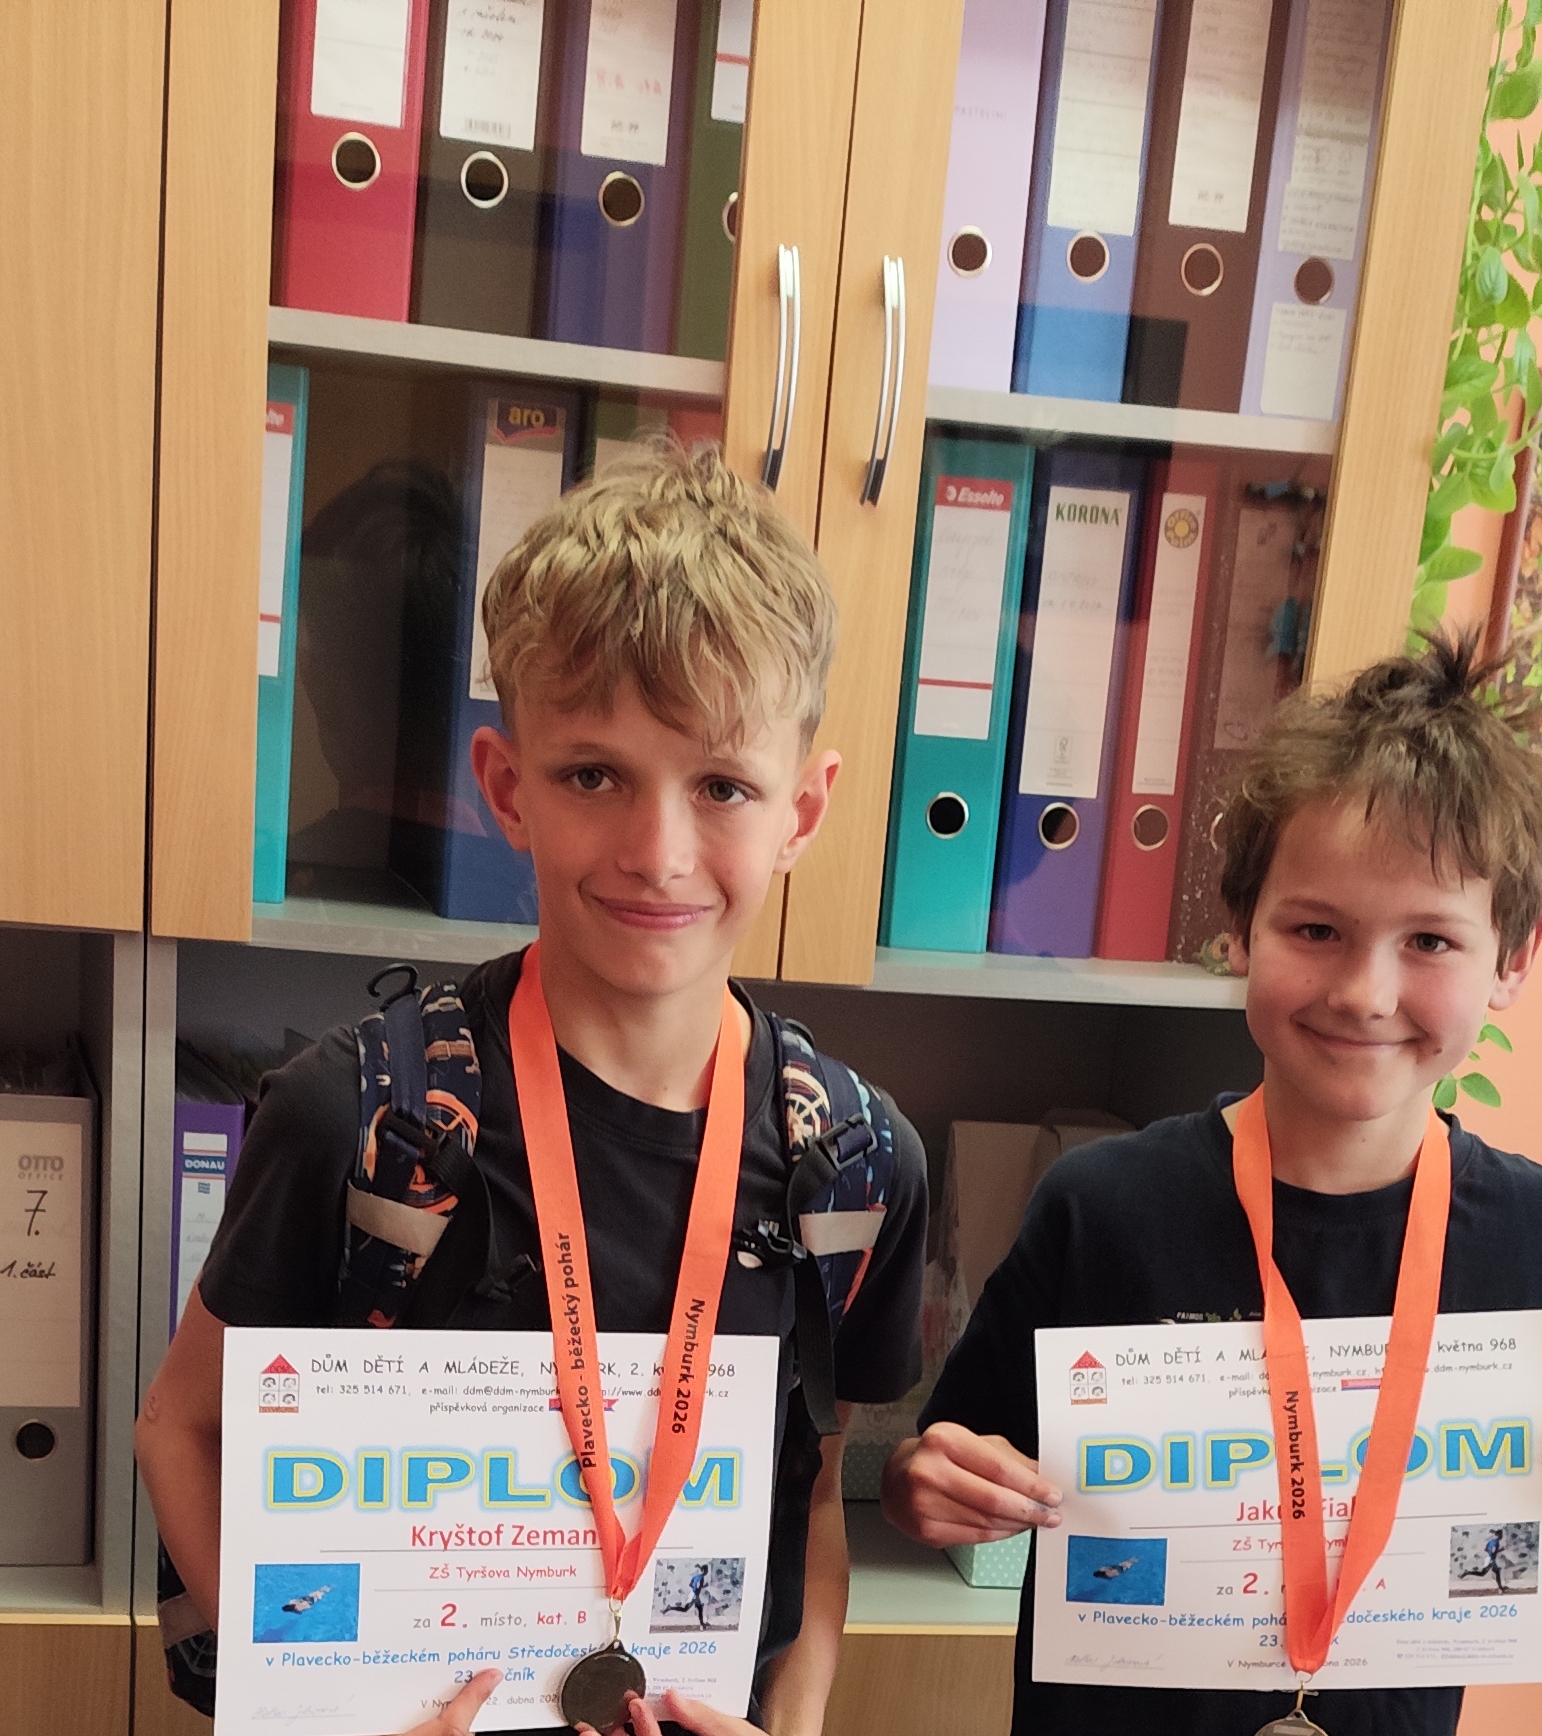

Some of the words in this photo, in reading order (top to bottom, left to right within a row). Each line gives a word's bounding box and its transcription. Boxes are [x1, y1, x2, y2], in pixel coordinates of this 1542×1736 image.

[509, 406, 546, 428] aro
[1055, 502, 1120, 527] KORONA
[18, 1154, 64, 1172] OTTO
[185, 1159, 225, 1171] DONAU
[18, 1172, 64, 1181] OFFICE
[24, 1190, 49, 1236] 7.
[557, 1232, 580, 1288] pohár
[564, 1293, 585, 1370] běžecký
[677, 1298, 705, 1384] Nymburk
[1115, 1347, 1151, 1367] DŮM
[1164, 1347, 1201, 1365] DĚTÍ
[1216, 1351, 1226, 1362] A
[1437, 1339, 1484, 1354] května
[1490, 1338, 1517, 1351] 968
[311, 1353, 348, 1373] DŮM
[363, 1355, 404, 1374] DĚTÍ
[419, 1360, 430, 1374] A
[444, 1356, 525, 1377] MLÁDEŽE,
[708, 1364, 735, 1377] 968
[339, 1384, 359, 1395] 325
[364, 1384, 384, 1395] 514
[430, 1402, 488, 1414] příspěvková
[492, 1403, 544, 1415] organizace
[671, 1387, 691, 1434] 2026
[576, 1385, 596, 1468] Plavecko
[1283, 1391, 1305, 1474] Nymburk
[1291, 1476, 1305, 1520] 2026
[411, 1523, 504, 1552] Kryštof
[1233, 1536, 1252, 1551] ZŠ
[429, 1563, 450, 1579] ZŠ
[456, 1565, 510, 1582] Tyršova
[517, 1564, 577, 1581] Nymburk
[1216, 1585, 1233, 1596] za
[1243, 1573, 1269, 1596] 2.
[1376, 1578, 1387, 1590] A
[413, 1618, 431, 1629] za
[440, 1603, 468, 1629] 2.
[480, 1612, 527, 1628] místo,
[536, 1611, 568, 1626] kat.
[577, 1611, 587, 1624] B
[1078, 1613, 1087, 1623] v
[1093, 1611, 1244, 1627] Plavecko-běžeckém
[1432, 1606, 1472, 1624] kraje
[1479, 1604, 1518, 1618] 2026
[266, 1657, 275, 1667] v
[281, 1649, 441, 1668] Plavecko-běžeckém
[448, 1645, 501, 1664] poháru
[631, 1641, 671, 1660] kraje
[679, 1641, 717, 1655] 2026
[1239, 1660, 1286, 1670] Nymburce
[1344, 1658, 1368, 1667] 2026
[507, 1695, 535, 1705] dubna
